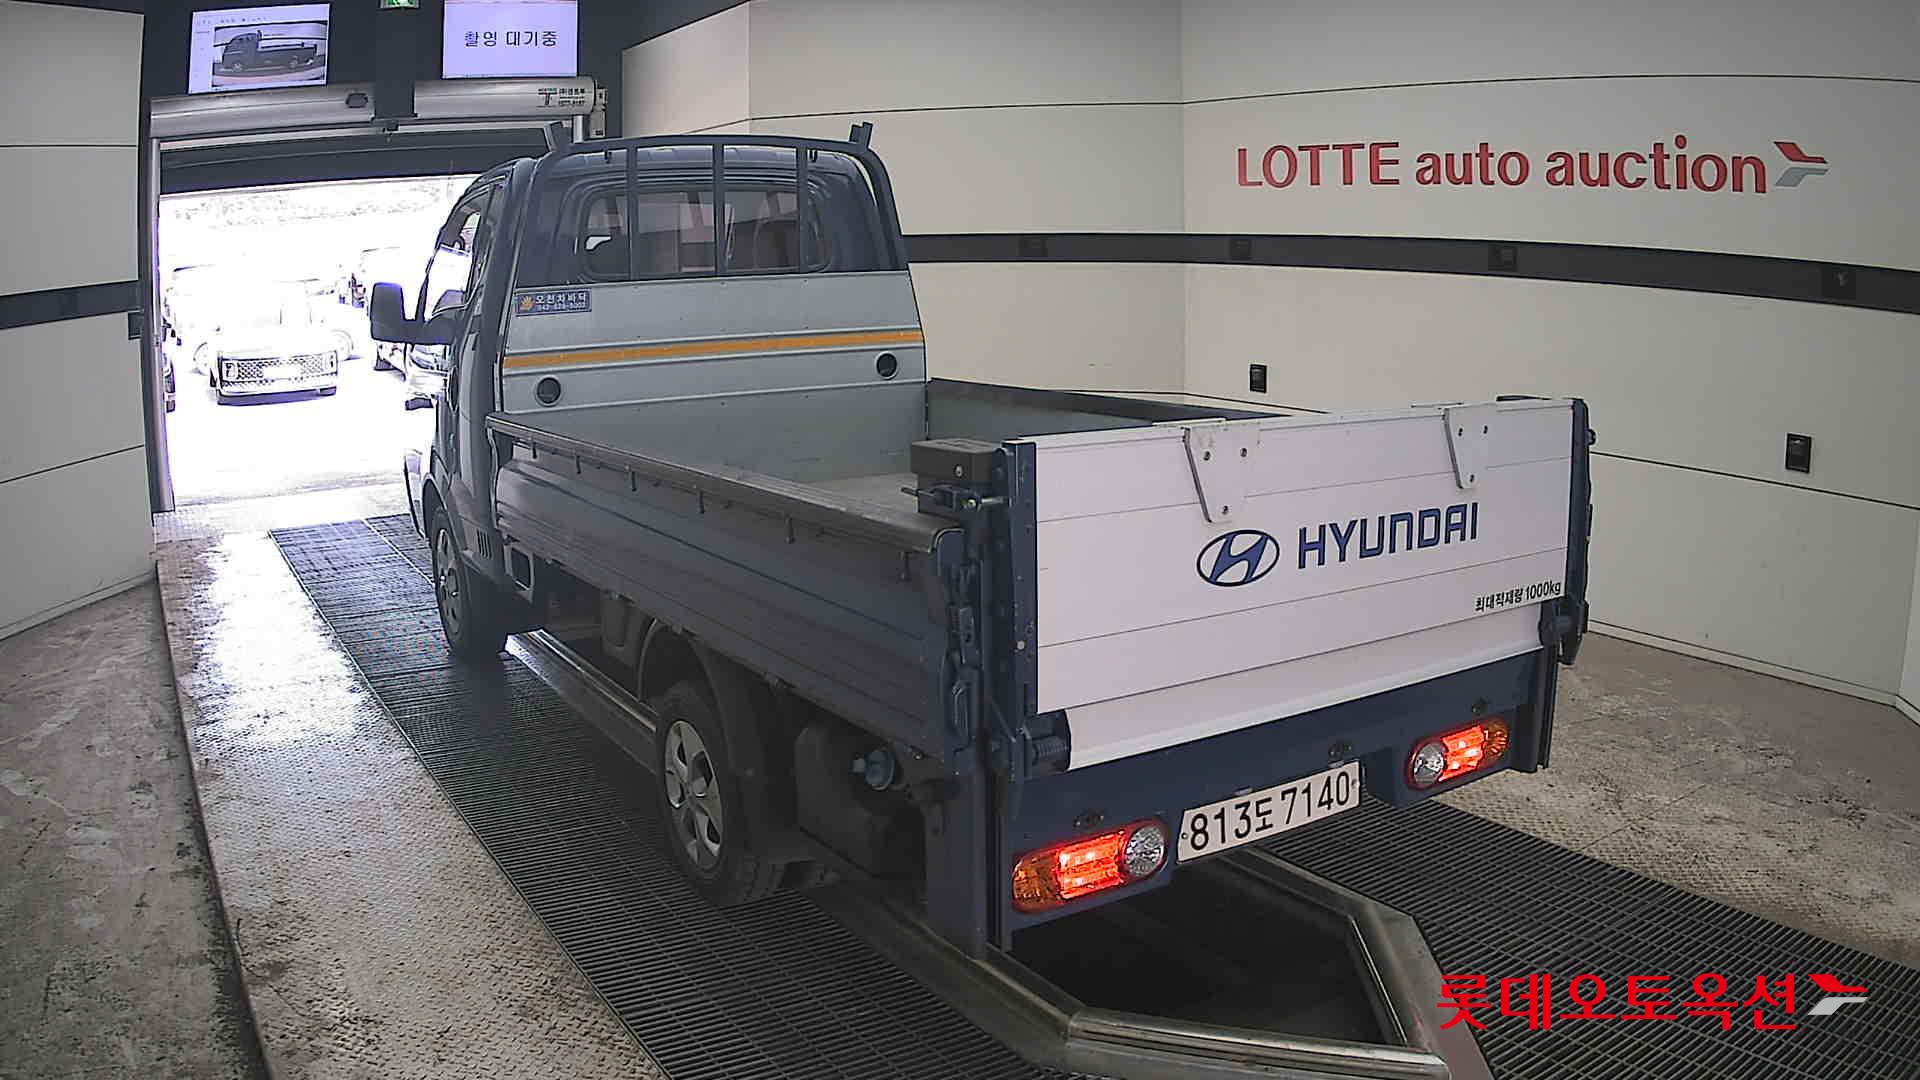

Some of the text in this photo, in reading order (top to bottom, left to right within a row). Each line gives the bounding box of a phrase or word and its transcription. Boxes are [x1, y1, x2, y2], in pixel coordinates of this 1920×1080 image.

[464, 31, 557, 47] 촬영 대기중
[1236, 134, 1767, 194] LOTTE auto auction
[1298, 502, 1479, 569] HYUNDAI
[1475, 579, 1562, 612] 최대적재량 1000kg
[1190, 770, 1350, 851] 813도 7140
